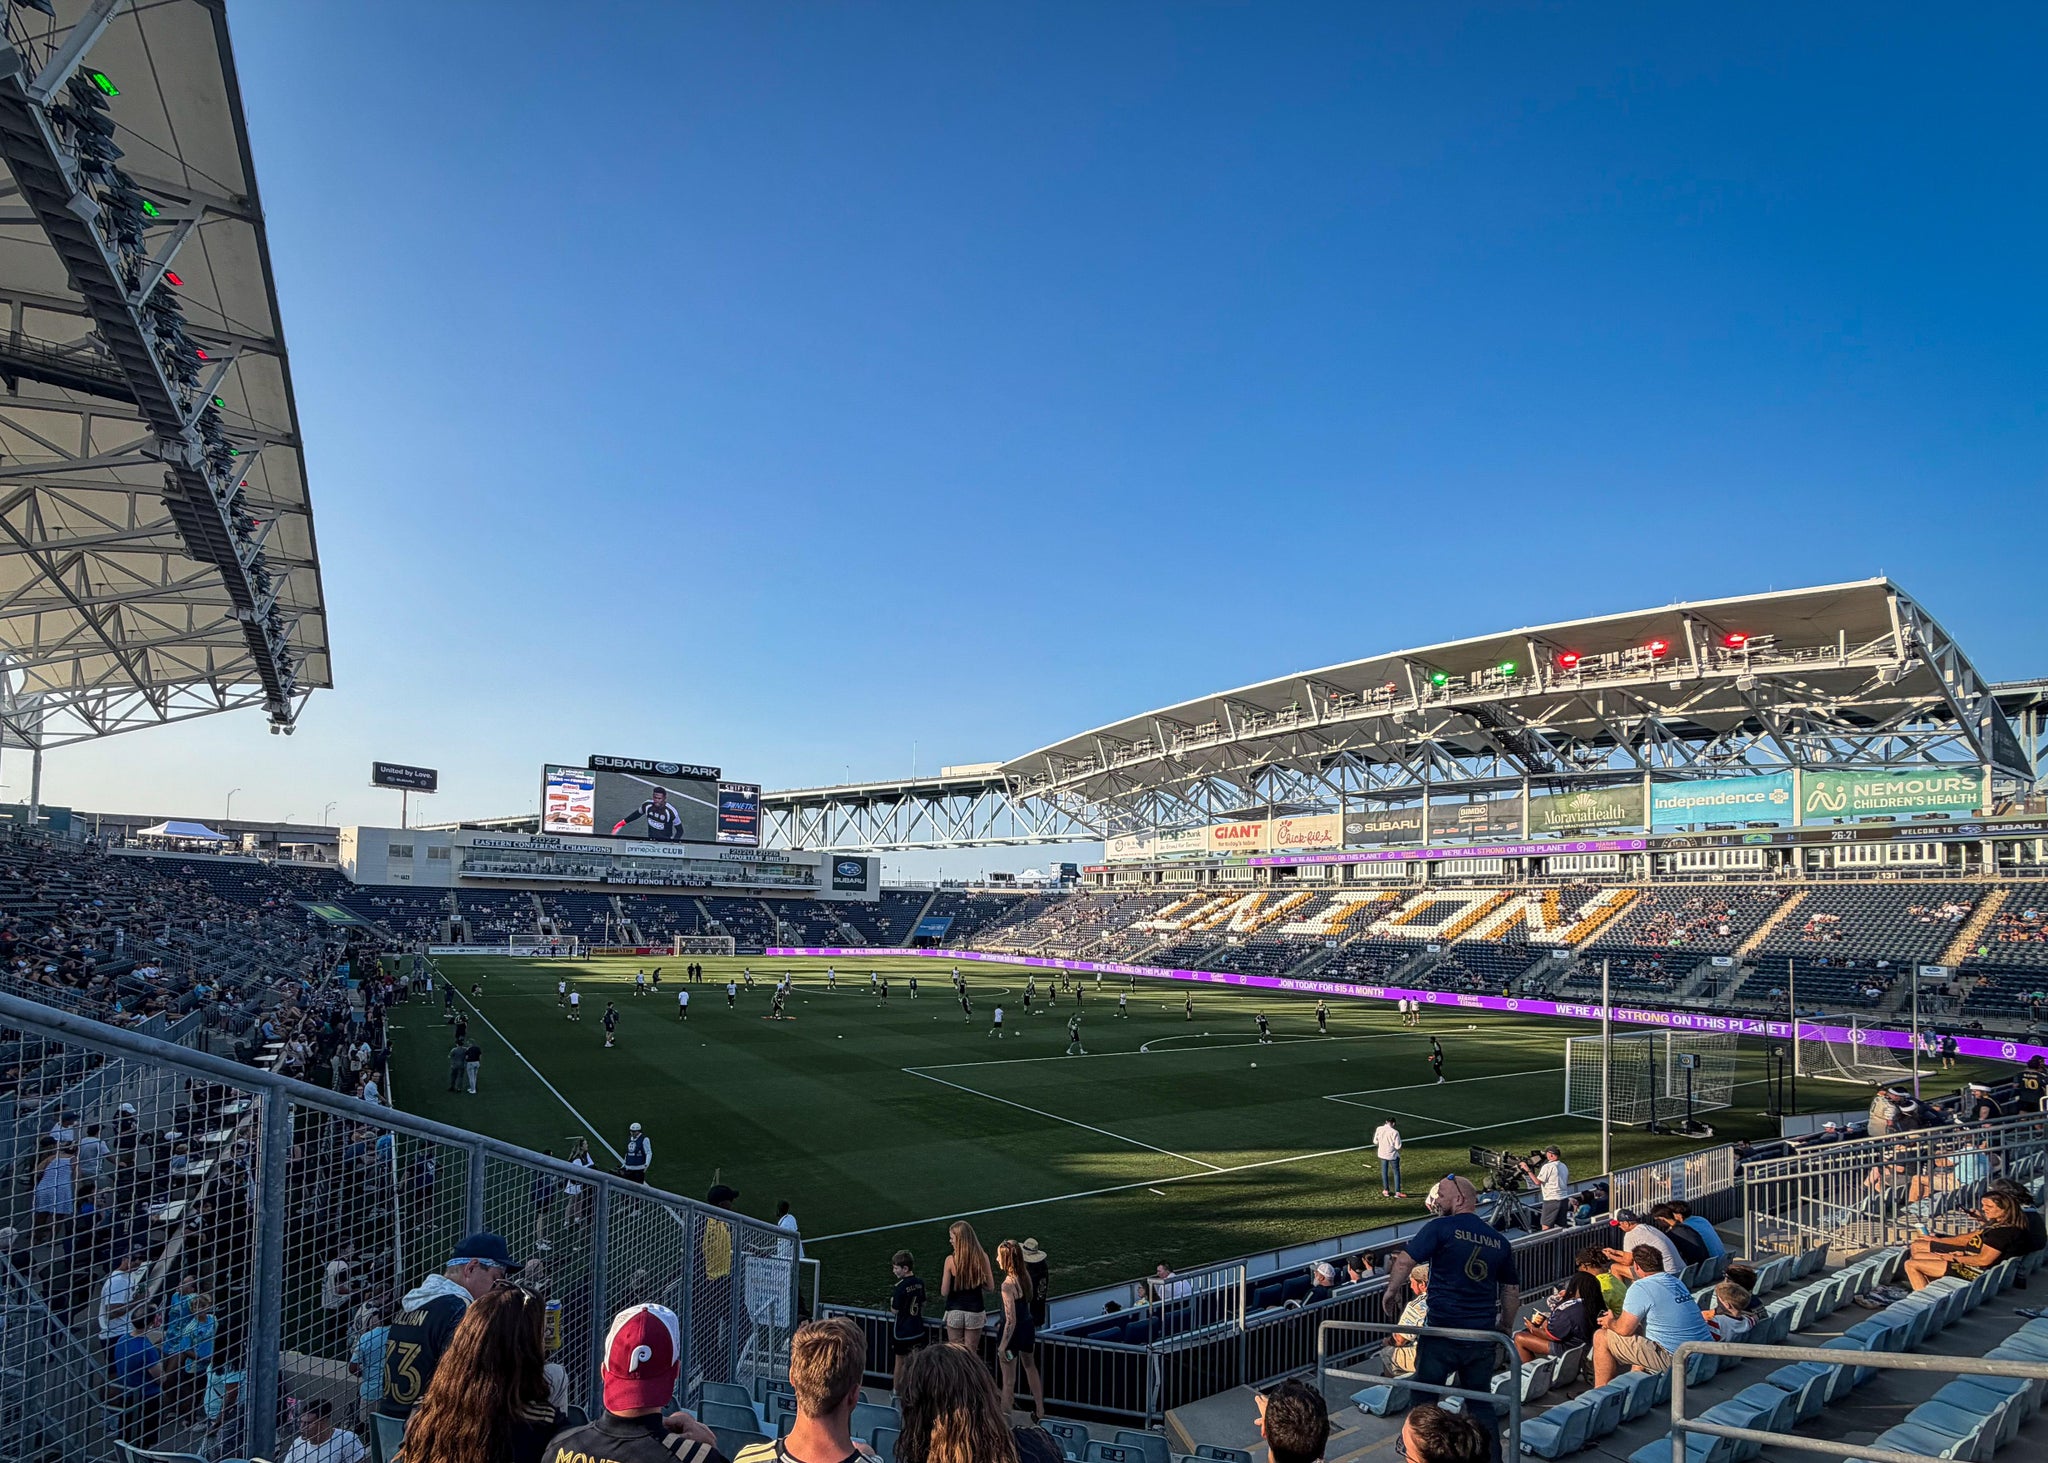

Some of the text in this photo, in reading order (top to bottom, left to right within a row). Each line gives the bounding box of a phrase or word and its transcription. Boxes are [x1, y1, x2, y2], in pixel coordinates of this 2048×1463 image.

[380, 766, 433, 779] United by Love.
[594, 756, 718, 777] SUBARU PARK
[1853, 777, 1977, 797] NEMOURS
[1655, 792, 1765, 809] Independence
[1853, 793, 1977, 810] CHILDREN'S HEALTH
[1460, 807, 1486, 816] BIMBO
[1544, 804, 1626, 825] MoraviaHealth
[1214, 824, 1262, 839] GIANT
[1364, 819, 1421, 832] SUBARU
[1901, 827, 1939, 835] WELCOME
[1986, 823, 2042, 832] SUBARU
[531, 836, 559, 844] 2022
[1160, 828, 1201, 841] WSFS Bank
[475, 839, 611, 853] EASTERN CONFERENCE CHAMPIONS
[627, 845, 683, 855] primepoint CLUB
[1442, 848, 1463, 856] WE'RE
[1463, 847, 1477, 855] ALL
[1477, 846, 1505, 854] STRONG
[1506, 845, 1517, 853] ON
[1518, 844, 1536, 852] THIS
[638, 878, 664, 886] HONOR
[833, 876, 866, 884] SUBARU
[1278, 979, 1384, 996] JOIN TODAY FOR $15 A MONTH
[1555, 1004, 1591, 1016] WE'RE
[1618, 1009, 1670, 1023] STRONG
[1672, 1014, 1692, 1026] ON
[1693, 1016, 1727, 1029] THIS
[1730, 1020, 1790, 1035] PLANET
[2022, 1077, 2039, 1090] 10
[1454, 1229, 1501, 1249] SULLIVAN
[1464, 1247, 1488, 1282] 6
[629, 1344, 652, 1373] P
